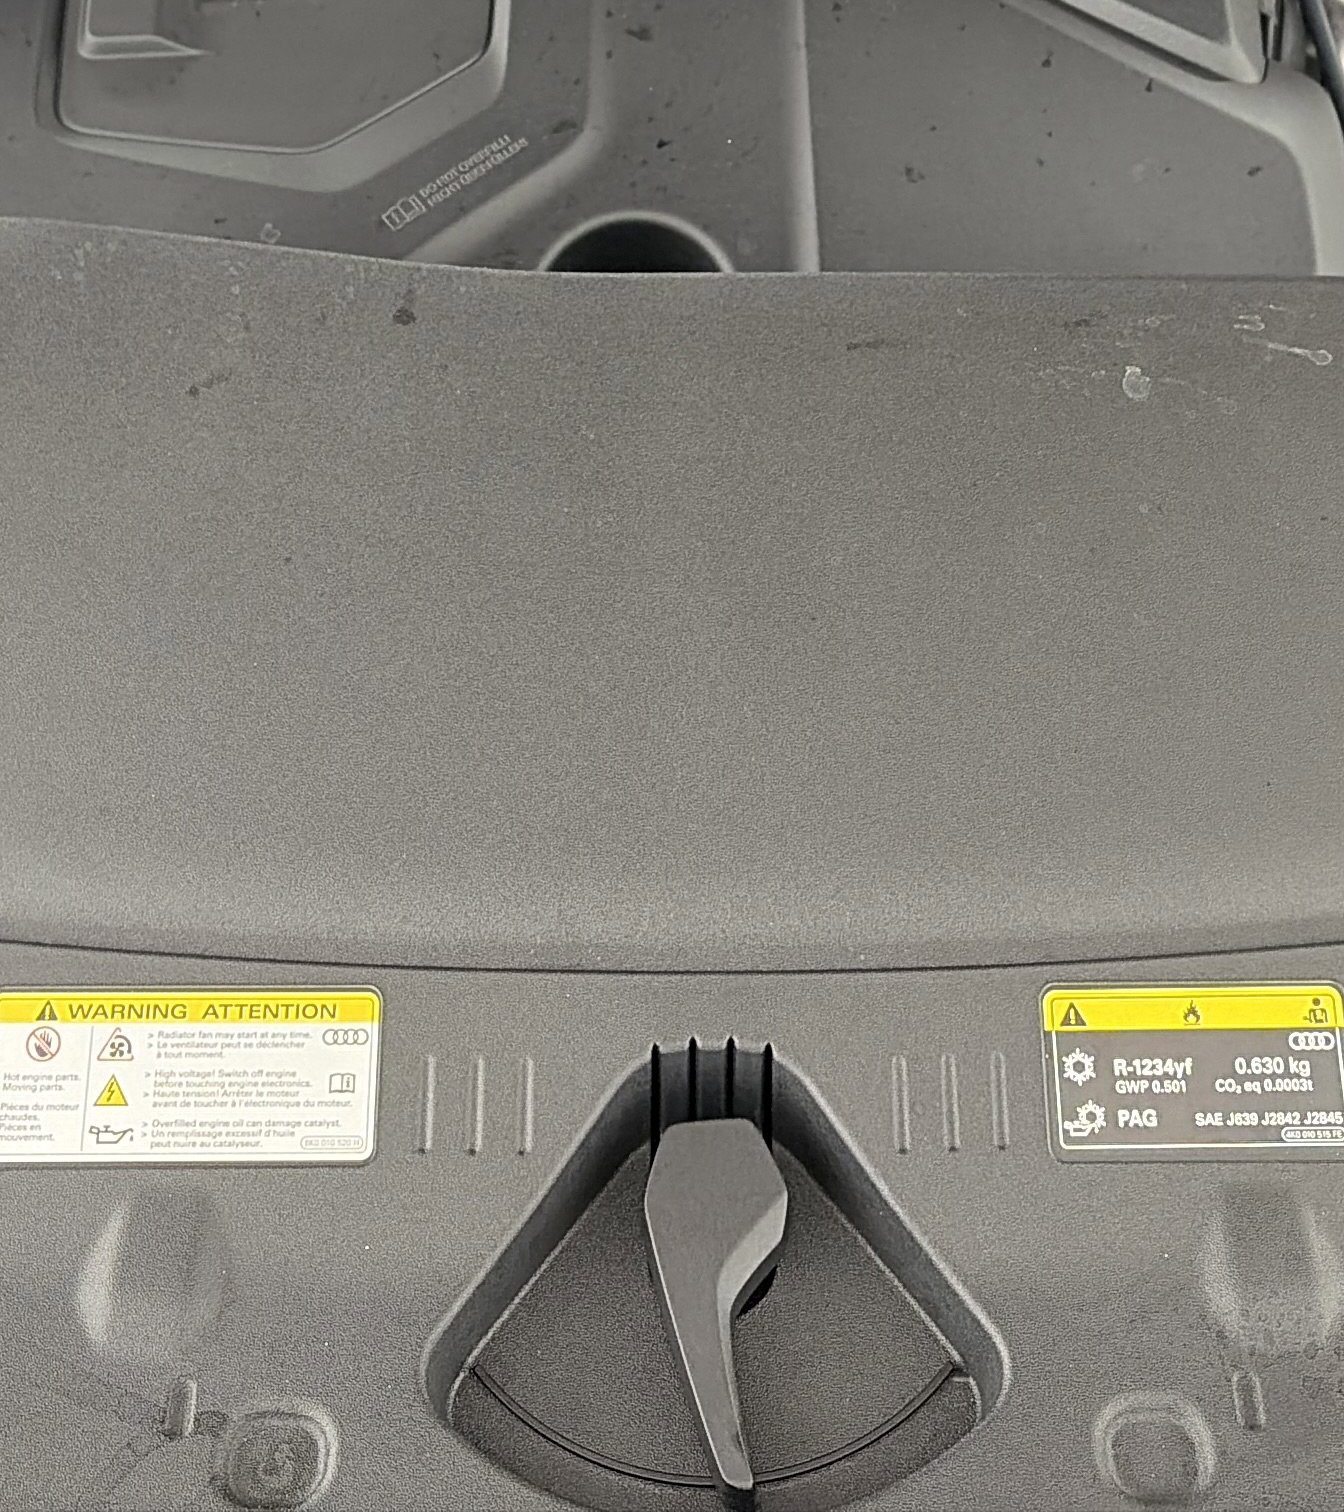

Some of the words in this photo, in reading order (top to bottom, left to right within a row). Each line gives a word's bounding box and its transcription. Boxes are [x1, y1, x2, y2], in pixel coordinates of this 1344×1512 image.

[67, 1003, 187, 1020] WARNING
[201, 1003, 337, 1020] ATTENTION
[157, 1030, 196, 1039] Radiator
[198, 1030, 213, 1039] fan
[215, 1031, 235, 1040] may
[237, 1031, 257, 1039] start
[260, 1031, 269, 1039] at
[271, 1032, 287, 1040] any
[157, 1041, 167, 1049] Le
[220, 1041, 241, 1050] peut
[1113, 1057, 1192, 1079] R-1234yf
[1234, 1056, 1285, 1075] 0.630
[1288, 1056, 1311, 1077] kg
[3, 1073, 20, 1081] Hot
[22, 1073, 53, 1082] engine
[154, 1069, 176, 1079] High
[217, 1069, 249, 1078] Switch
[265, 1070, 297, 1079] engine
[2, 1083, 37, 1093] Moving
[153, 1080, 183, 1088] before
[185, 1080, 225, 1089] touching
[228, 1080, 259, 1089] engine
[1115, 1080, 1149, 1095] GWP
[1151, 1079, 1187, 1094] 0.501
[1243, 1081, 1262, 1094] eq
[1263, 1078, 1314, 1092] 0.0003t
[153, 1090, 180, 1098] Haute
[32, 1102, 44, 1110] du
[46, 1103, 79, 1111] moteur
[152, 1100, 178, 1108] avant
[179, 1099, 191, 1108] de
[193, 1100, 228, 1108] toucher
[303, 1099, 315, 1107] du
[152, 1119, 196, 1128] Overfilled
[198, 1120, 230, 1129] engine
[232, 1119, 244, 1127] oil
[264, 1119, 302, 1128] damage
[1117, 1110, 1158, 1128] PAG
[1195, 1112, 1224, 1127] SAE
[1226, 1112, 1259, 1126] J639
[1261, 1112, 1301, 1125] J2842
[1303, 1111, 1344, 1125] J2845
[151, 1129, 165, 1138] Un
[167, 1130, 223, 1140] remplissage
[225, 1129, 262, 1137] excessif
[150, 1141, 171, 1150] peut
[173, 1140, 197, 1148] nuire
